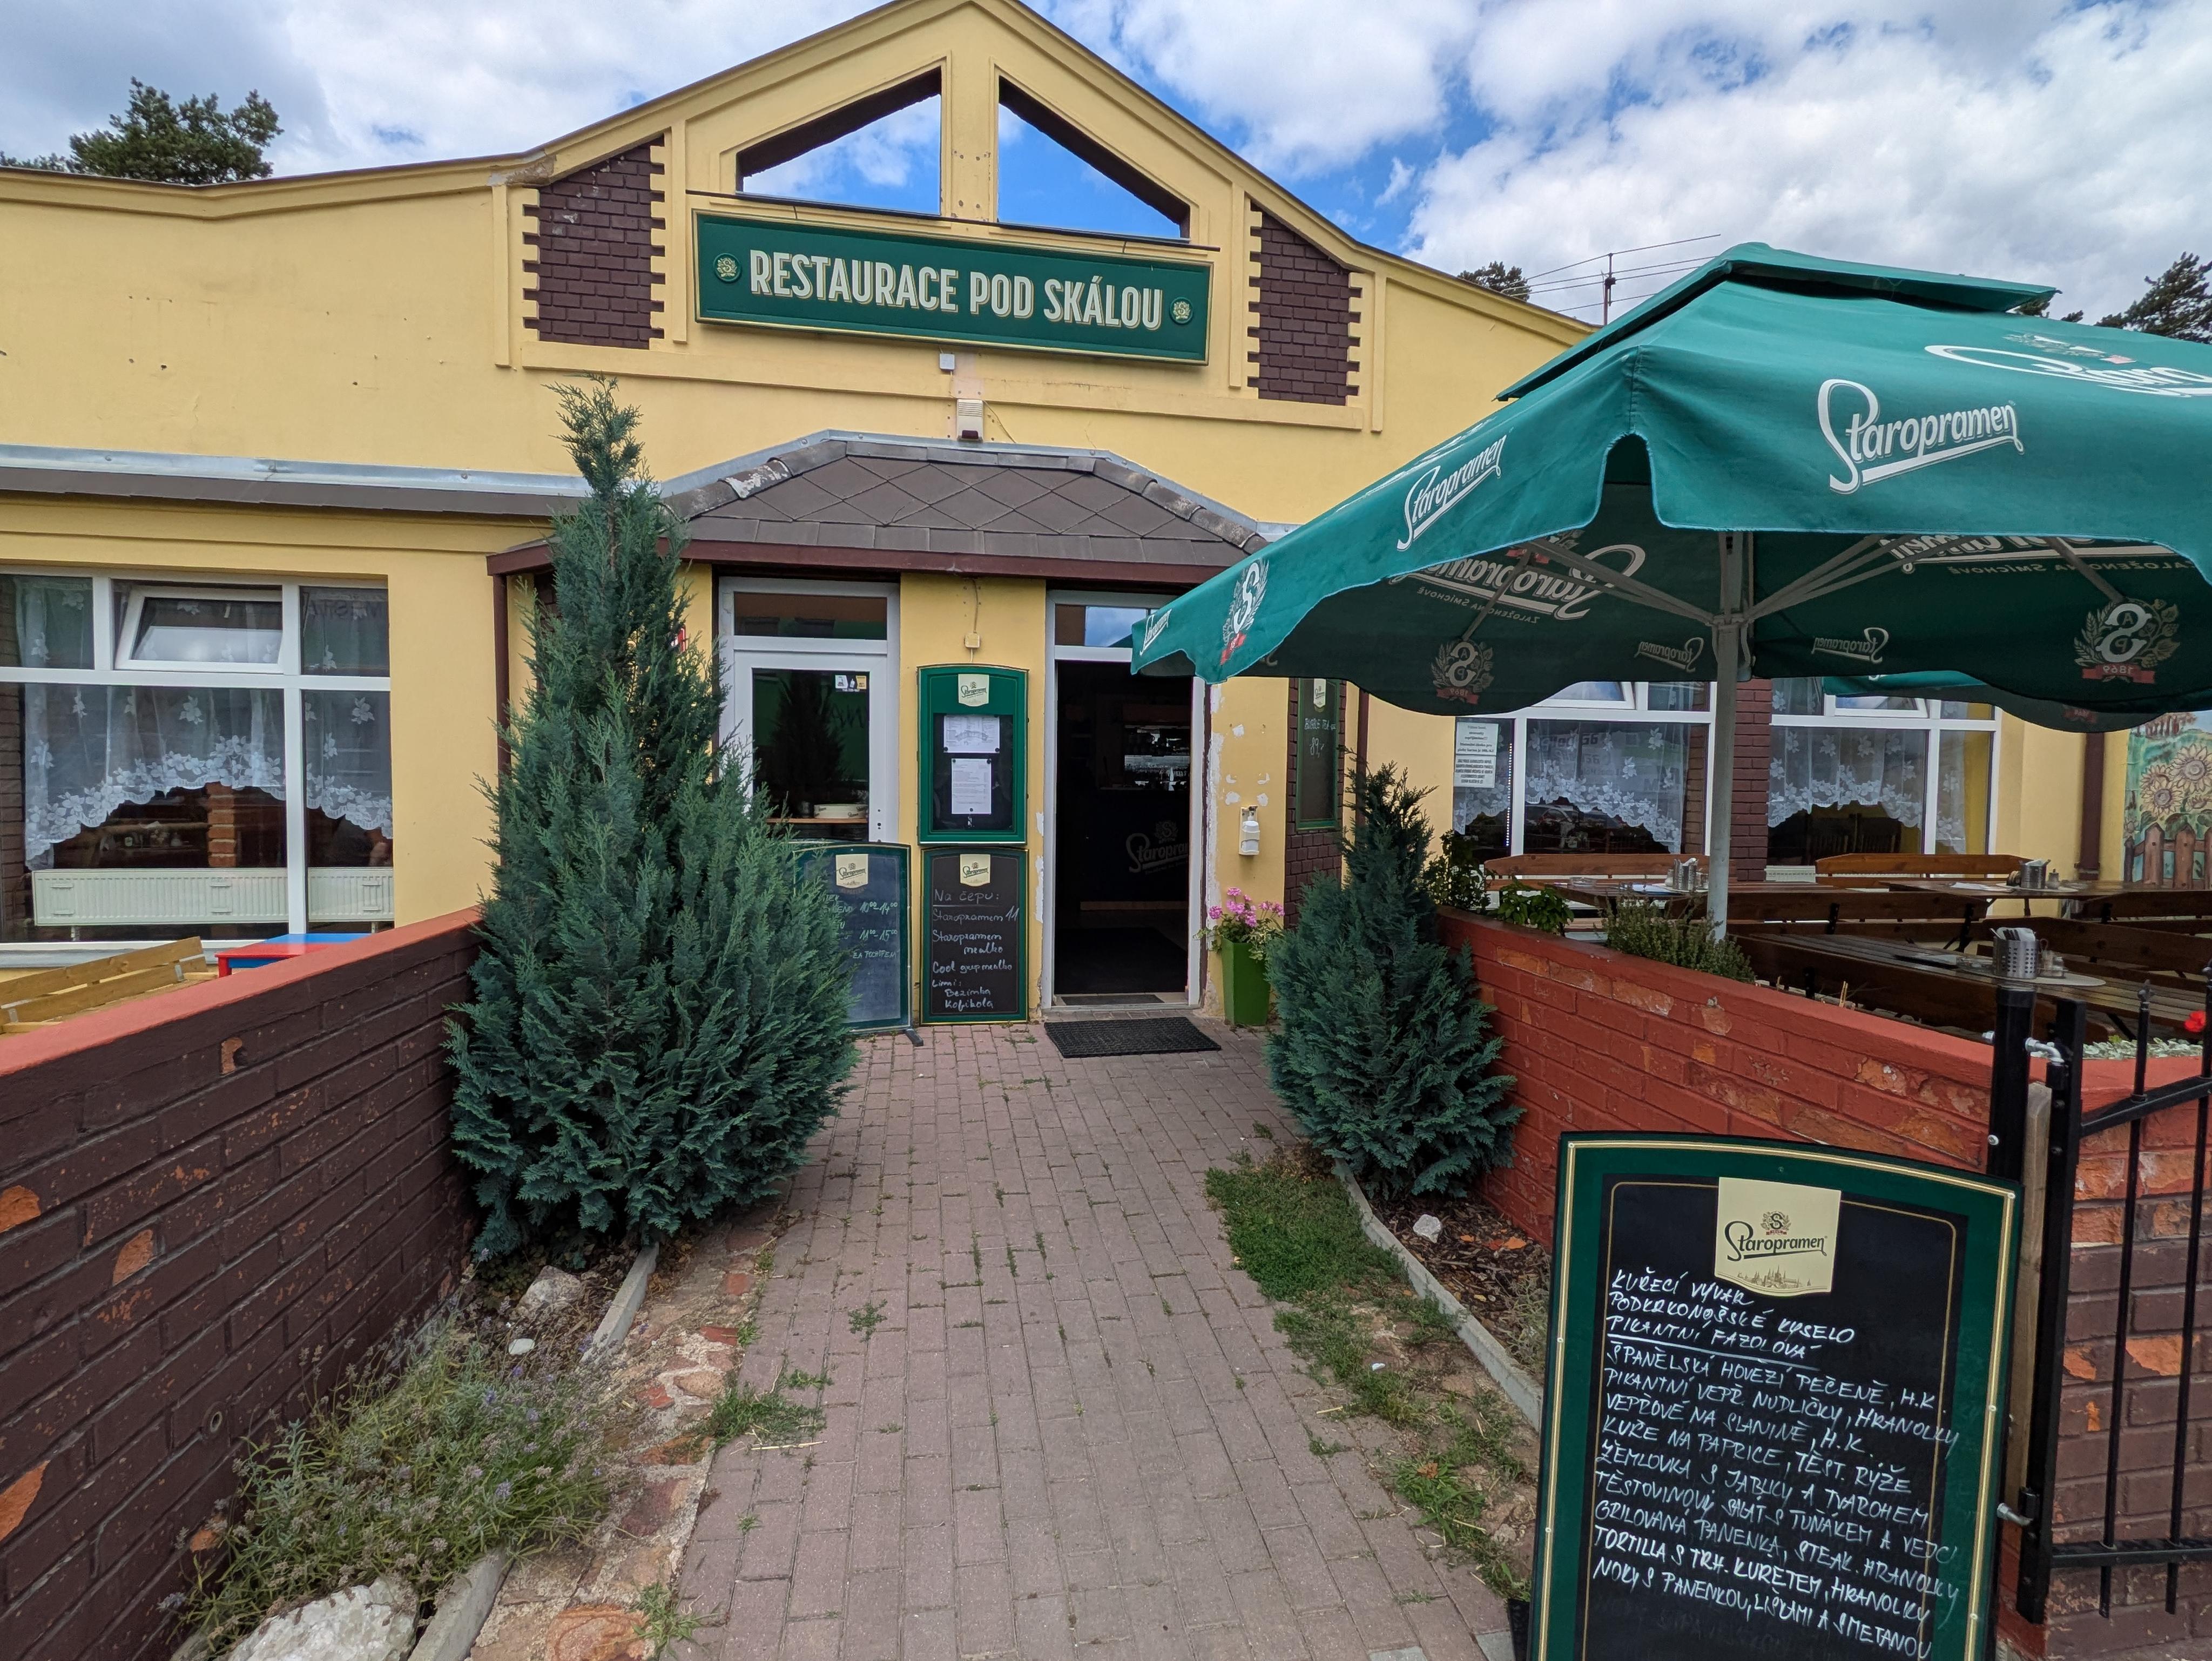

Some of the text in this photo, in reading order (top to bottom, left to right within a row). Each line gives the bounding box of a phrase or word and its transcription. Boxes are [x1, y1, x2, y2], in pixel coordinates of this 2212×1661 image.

[750, 249, 1164, 332] RESTAURACE POD SKÁLOU
[1818, 379, 2025, 494] Staropramen
[1397, 434, 1507, 551] Staropramen
[934, 889, 1000, 905] Na čepu:
[933, 960, 955, 974] Cool
[1724, 1220, 1827, 1262] Staropramen
[1611, 1266, 1689, 1294] KUŘECÍ
[1606, 1315, 1822, 1359] PIKANTNÍ FAZOLOVÁ
[1777, 1318, 1856, 1343] KYSELO
[1607, 1341, 1715, 1376] ŠPANĚLSKÁ
[1721, 1359, 1793, 1386] HOVĚZÍ
[1604, 1368, 1695, 1396] PIKANTNÍ
[1854, 1407, 1960, 1460] HRANOLKY
[1606, 1392, 1690, 1420] VEPŘOVÉ
[1689, 1406, 1716, 1427] NA
[1602, 1414, 1660, 1441] KUŘE
[1667, 1428, 1691, 1450] NA
[1701, 1463, 1718, 1485] S
[1801, 1483, 1815, 1506] A
[1824, 1488, 1930, 1530] TVAROHEM
[1764, 1508, 1784, 1527] S
[1789, 1508, 1873, 1547] TUŇÁKEM
[1879, 1529, 1891, 1550] A
[1594, 1499, 1690, 1536] GRILOVANÁ
[1863, 1557, 1960, 1630] HRANOLKY
[1594, 1524, 1665, 1563] TORTILLA
[1671, 1544, 1685, 1567] S
[1831, 1575, 1931, 1636] HRANOLKY
[1593, 1556, 1640, 1594] NOKY
[1642, 1567, 1655, 1589] S
[1816, 1609, 1830, 1631] A
[1832, 1612, 1932, 1660] SMETANOU
